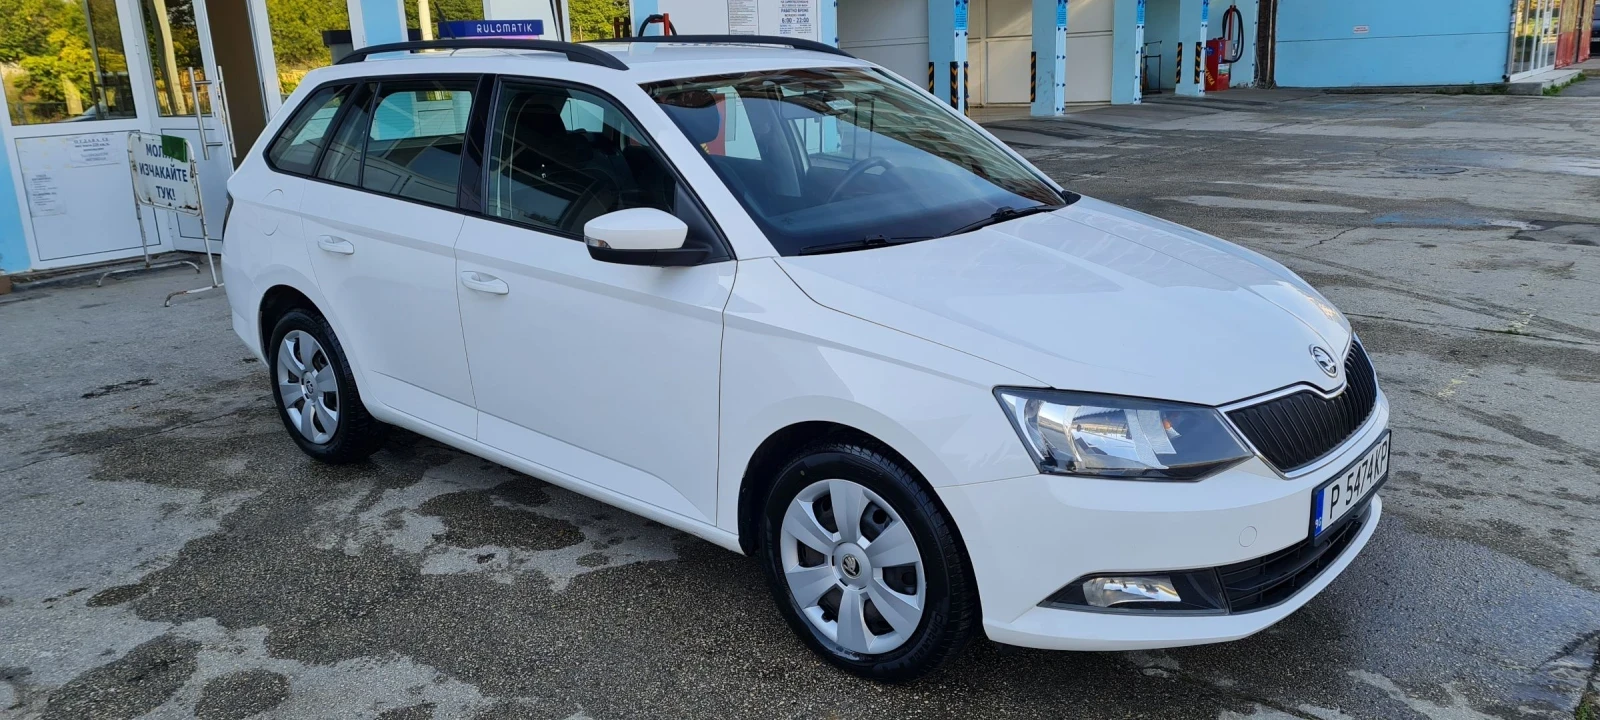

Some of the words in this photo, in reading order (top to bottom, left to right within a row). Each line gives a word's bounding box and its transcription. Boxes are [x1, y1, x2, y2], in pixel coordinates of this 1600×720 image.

[476, 23, 533, 33] RULOMATIK
[139, 162, 188, 183] ИЗЧАКАЙТЕ
[155, 185, 176, 201] ТУК!
[1329, 483, 1340, 520] P
